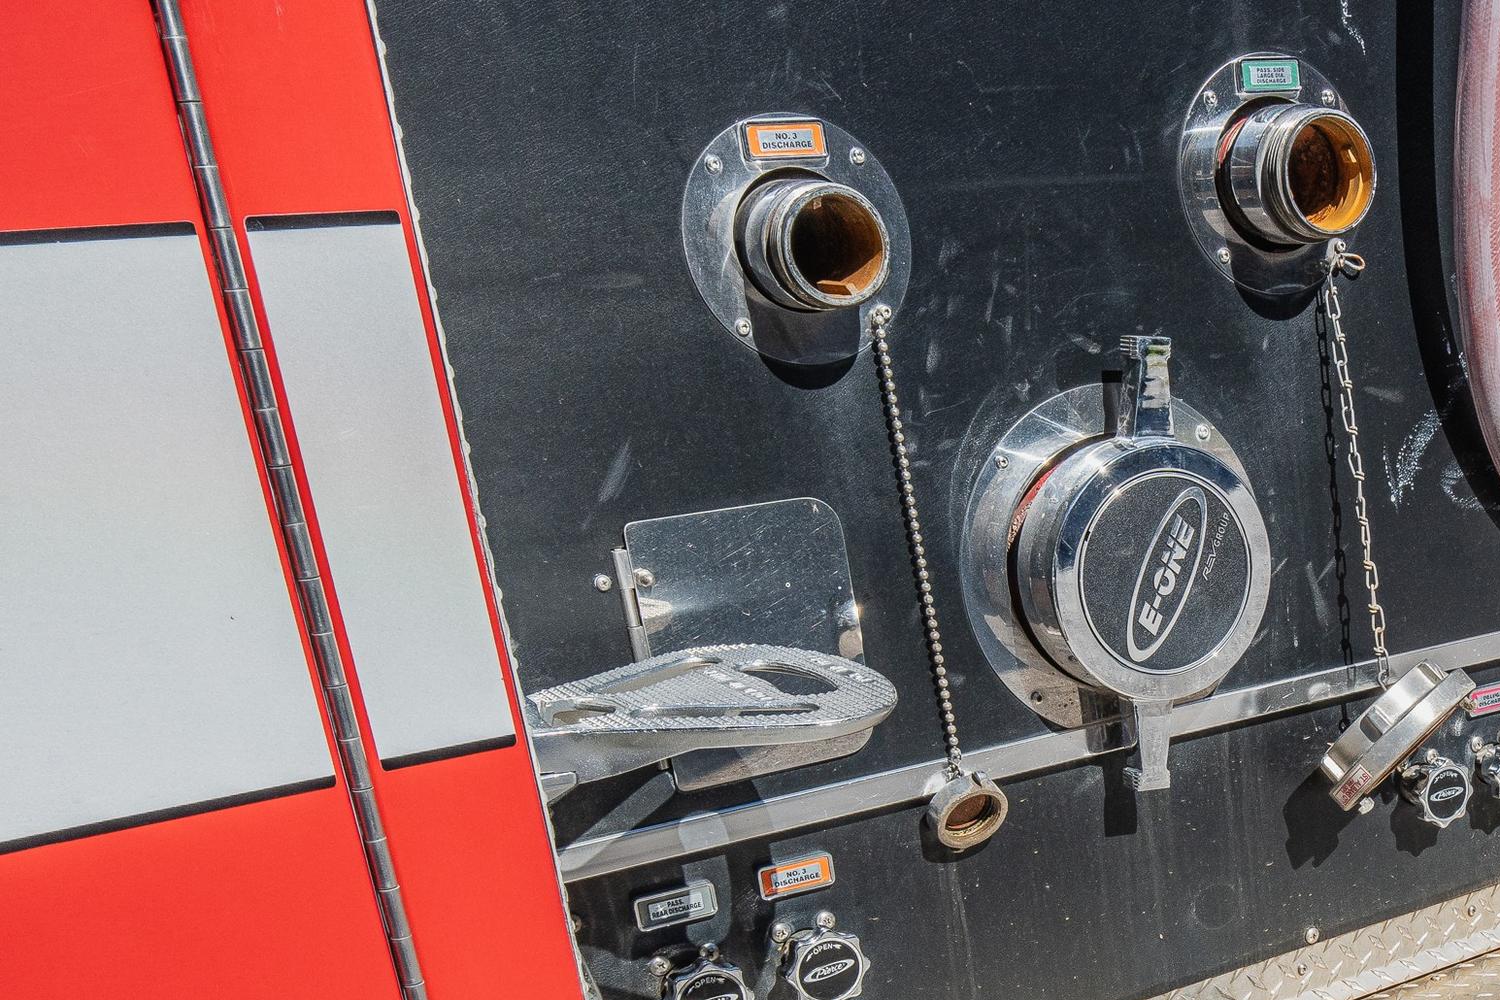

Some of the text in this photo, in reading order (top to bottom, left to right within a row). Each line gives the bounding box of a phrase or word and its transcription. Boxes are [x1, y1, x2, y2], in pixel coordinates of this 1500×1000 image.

[775, 132, 798, 140] NO. 3
[762, 140, 813, 150] DISCHARGE
[1213, 512, 1230, 548] GROUP
[1138, 513, 1195, 637] E-ONE
[774, 871, 821, 888] DISCHARGE
[786, 870, 801, 878] NO.
[651, 901, 702, 919] REAR DISCHARGE
[813, 943, 834, 955] OPEN
[815, 962, 845, 980] Pierce
[694, 976, 717, 989] OPEN
